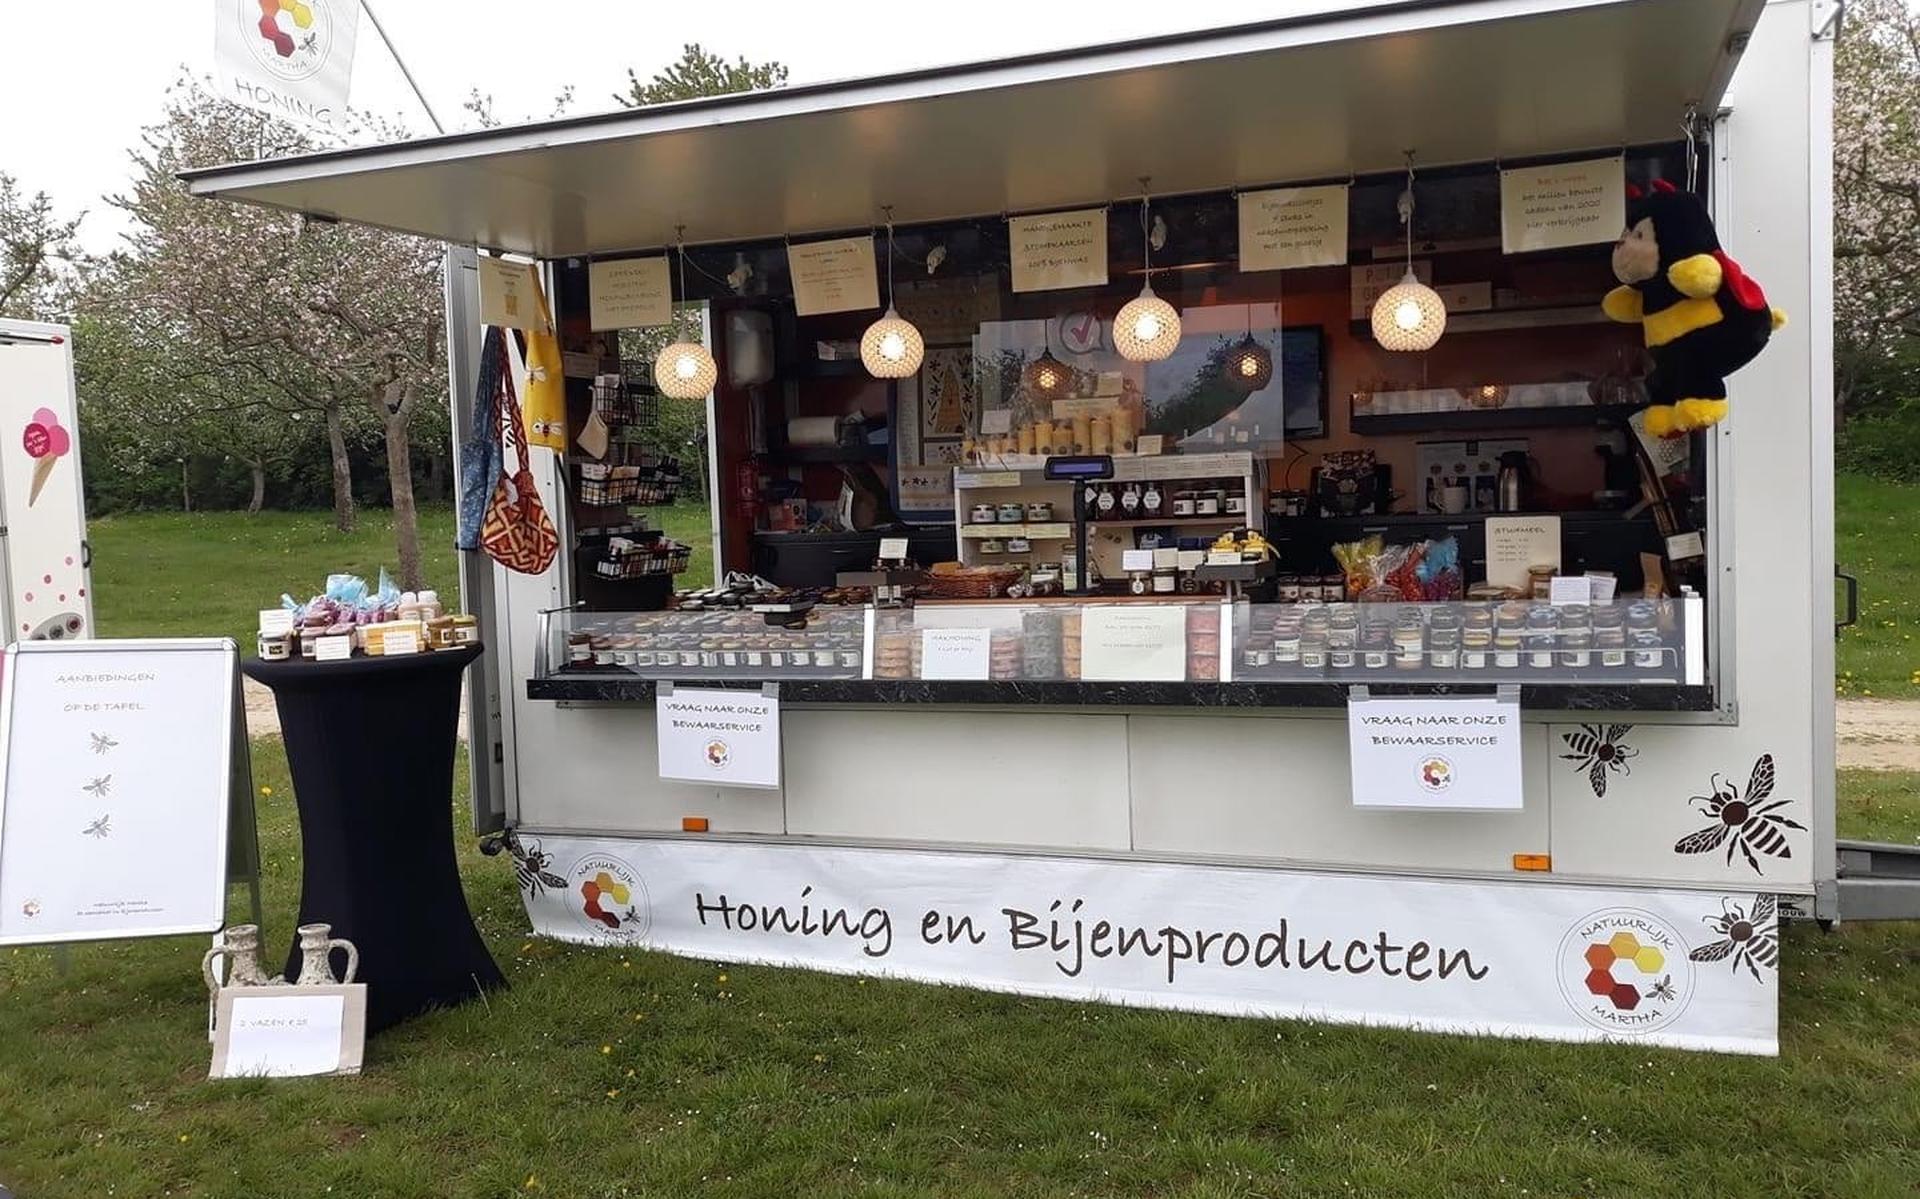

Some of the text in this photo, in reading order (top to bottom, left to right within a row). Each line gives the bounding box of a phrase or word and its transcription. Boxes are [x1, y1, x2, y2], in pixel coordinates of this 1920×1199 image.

[234, 77, 332, 127] HONING
[1577, 200, 1601, 209] 2020
[55, 672, 156, 684] AANBIEDINGEN
[103, 701, 146, 711] TAFEL
[665, 703, 769, 715] VRAAG NAAR ONZE
[671, 719, 762, 732] BEWAARSERVICE
[1361, 715, 1507, 727] VRAAG NAAR ONZE
[1371, 736, 1498, 746] BEWAARSERVICE
[578, 862, 635, 886] NATUURLIJK
[696, 886, 1489, 984] Honing en Bijenproducten
[1581, 916, 1674, 950] NATUURLIJK
[1590, 1004, 1663, 1026] MARTHA
